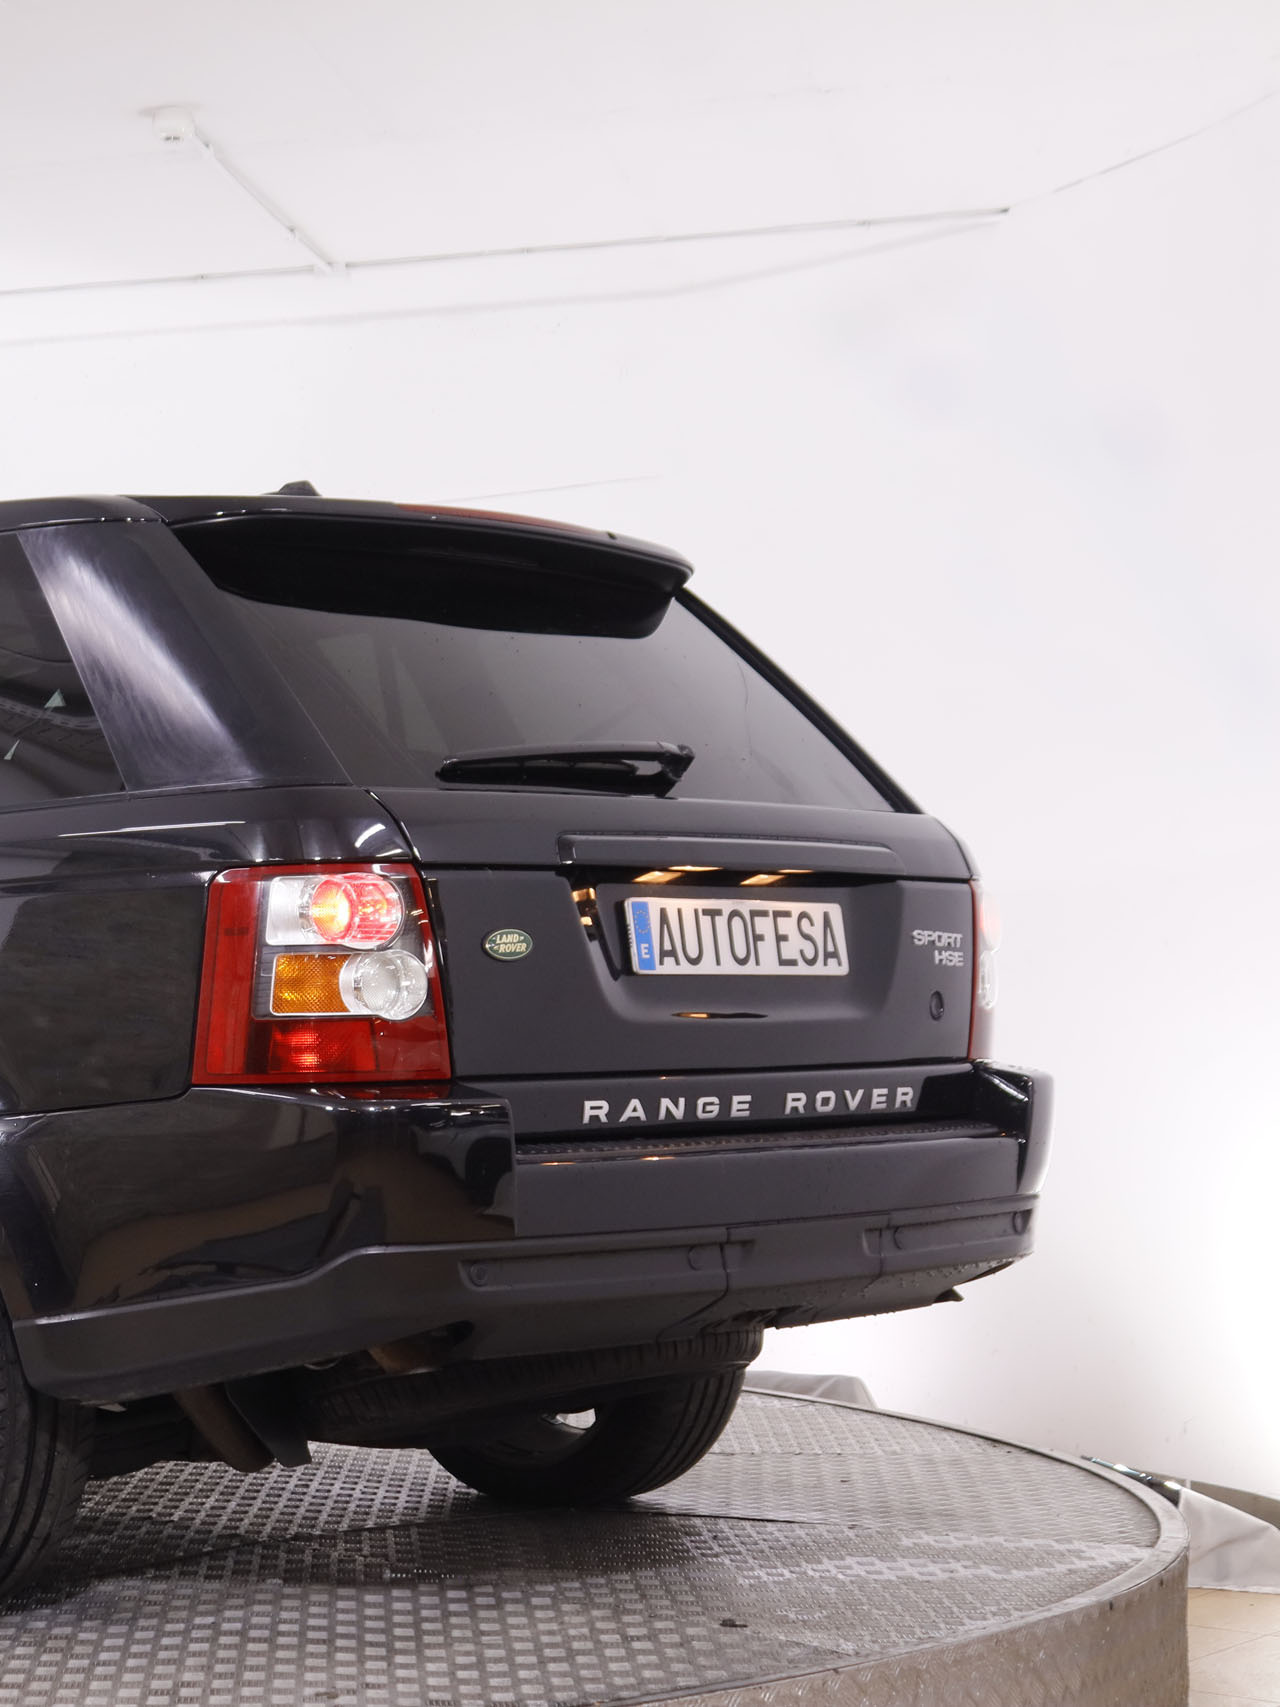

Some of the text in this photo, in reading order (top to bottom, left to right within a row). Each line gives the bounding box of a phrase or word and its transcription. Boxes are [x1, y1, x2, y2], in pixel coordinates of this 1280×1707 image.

[495, 933, 519, 944] LAND
[658, 907, 843, 967] AUTOFESA
[912, 929, 963, 948] SPORT
[498, 942, 527, 953] ROVER
[640, 943, 651, 959] E
[934, 949, 964, 967] HSE
[582, 1086, 915, 1125] RANGE ROVER
